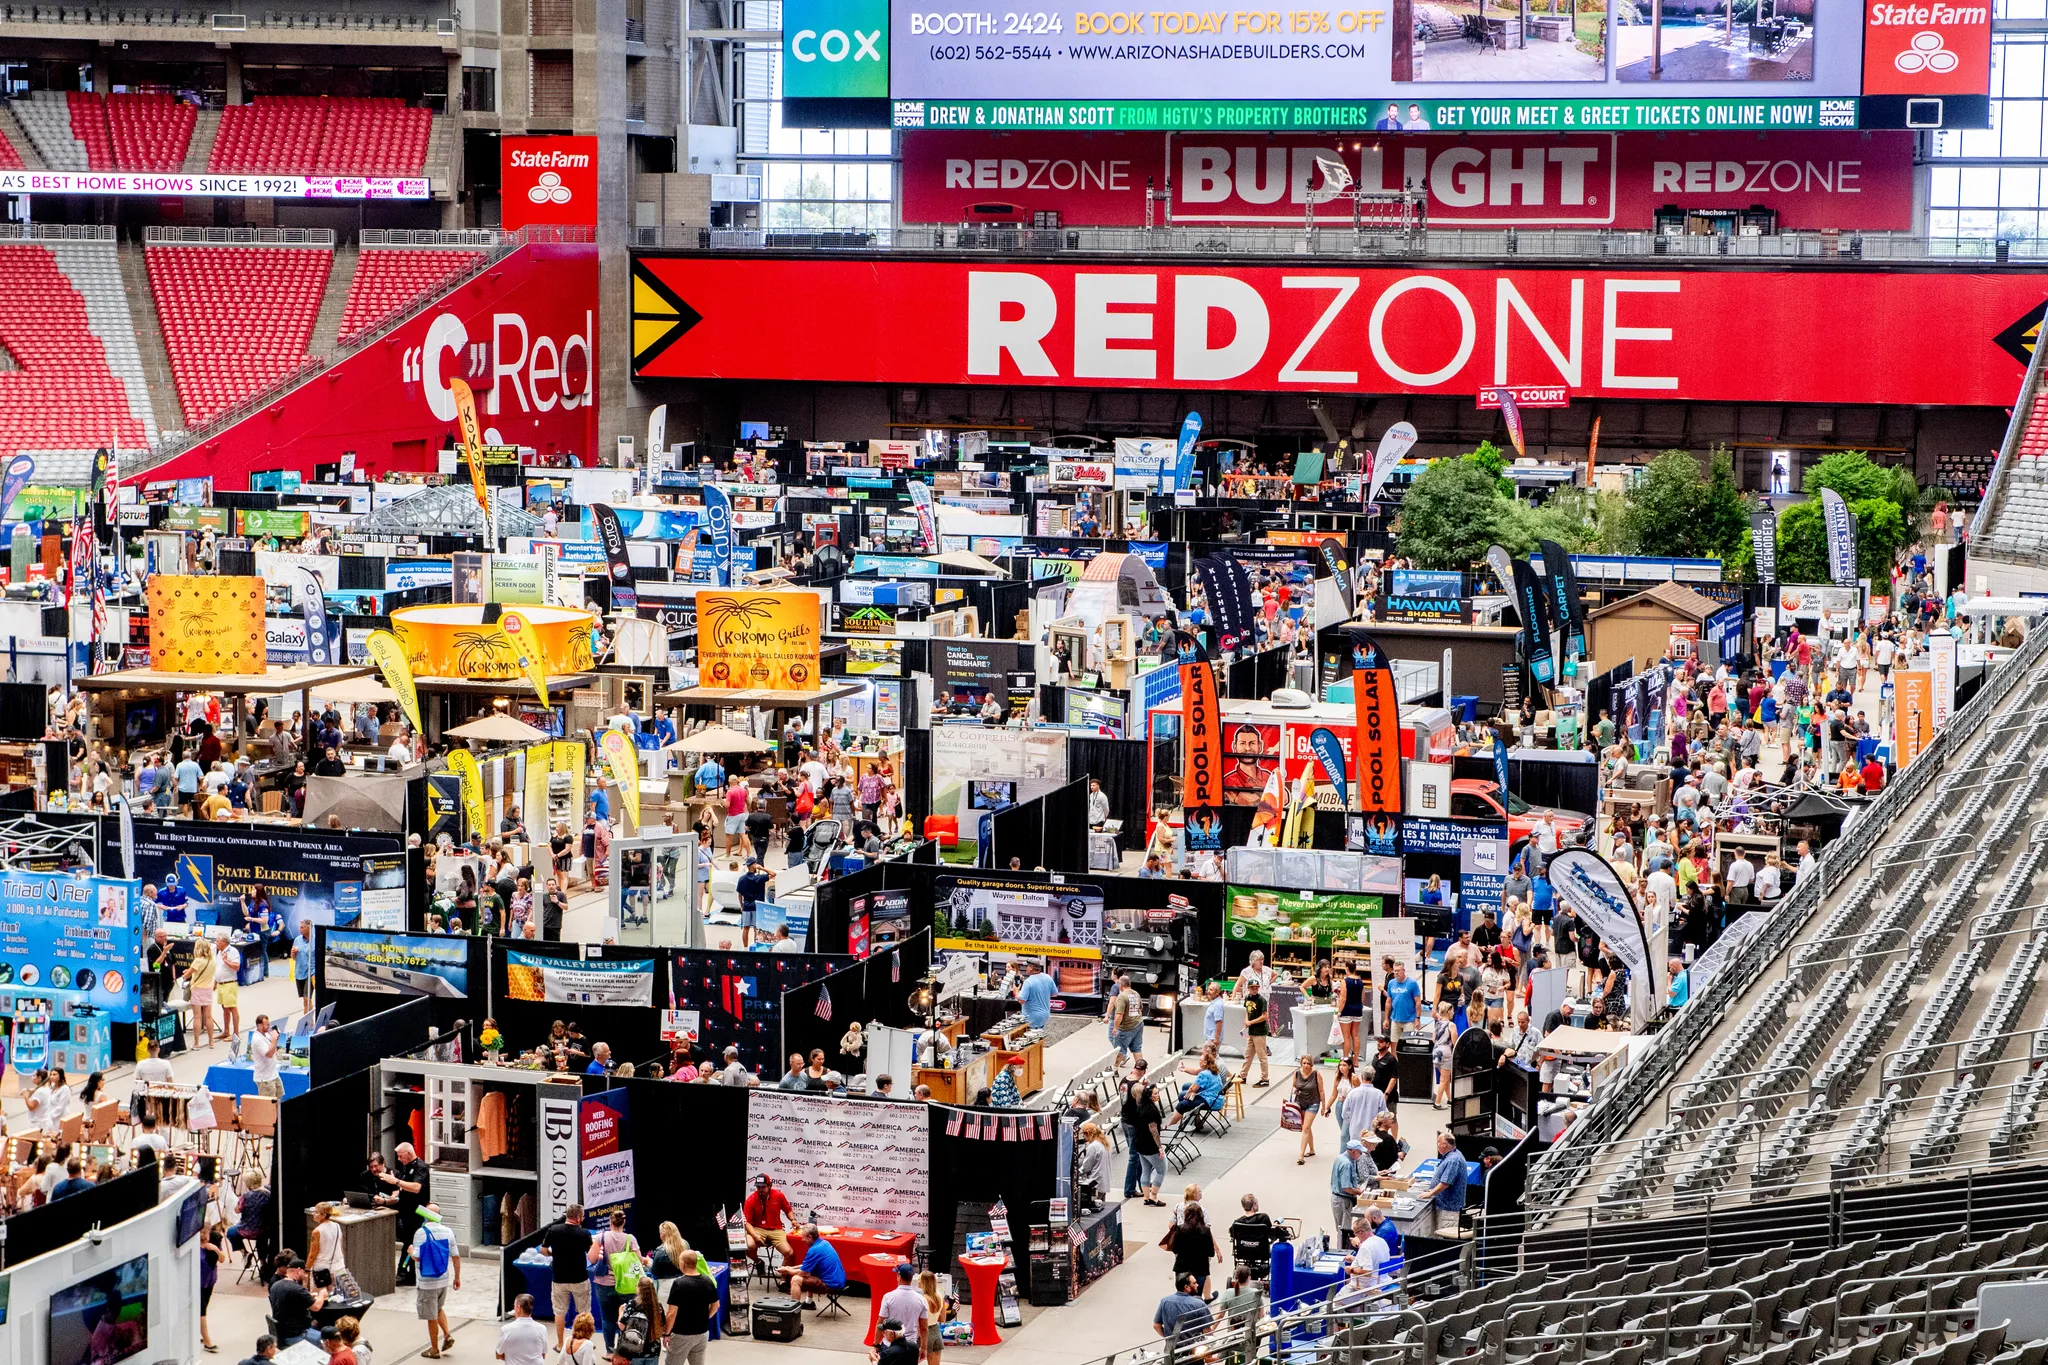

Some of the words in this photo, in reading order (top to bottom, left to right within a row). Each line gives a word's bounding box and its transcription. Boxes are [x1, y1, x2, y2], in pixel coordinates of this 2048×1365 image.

[911, 12, 998, 36] BOOTH:
[1003, 12, 1063, 36] 2424
[1074, 11, 1145, 34] BOOK
[1149, 11, 1228, 34] TODAY
[1233, 11, 1283, 33] FOR
[1288, 10, 1331, 33] 15%
[1336, 9, 1385, 33] OFF
[791, 30, 882, 62] COX
[929, 45, 971, 65] (602)
[975, 45, 1052, 64] 562-5544
[1068, 44, 1366, 61] WWW.ARIZONASHADEBUILDERS.COM
[929, 107, 971, 128] DREW
[975, 107, 987, 127] &
[990, 107, 1064, 127] JONATHAN
[1068, 106, 1115, 127] SCOTT
[1119, 107, 1158, 127] FROM
[1162, 106, 1213, 126] HGTV'S
[1217, 106, 1290, 126] PROPERTY
[1293, 106, 1368, 126] BROTHERS
[1437, 105, 1467, 126] GET
[1471, 105, 1511, 126] YOUR
[1516, 105, 1559, 126] MEET
[1563, 106, 1575, 126] &
[1580, 105, 1631, 126] GREET
[1635, 104, 1701, 125] TICKETS
[1705, 104, 1765, 124] ONLINE
[1769, 104, 1813, 124] NOW!
[945, 158, 1132, 191] REDZONE
[1182, 147, 1350, 205] BUD
[1360, 147, 1599, 208] LIGHT
[1653, 159, 1863, 193] REDZONE
[32, 175, 71, 189] BEST
[76, 177, 127, 191] HOME
[132, 178, 193, 191] SHOWS
[198, 179, 248, 193] SINCE
[254, 181, 298, 194] 1992!
[1698, 209, 1728, 217] Nachos
[966, 270, 1682, 392] REDZONE
[490, 309, 594, 416] Red
[1520, 389, 1566, 402] COURT
[1390, 428, 1412, 439] energy
[1073, 465, 1107, 483] Bulldog
[1835, 501, 1846, 530] MINI
[341, 533, 370, 543] BROUGHT
[370, 534, 380, 543] TO
[379, 534, 392, 544] YOU
[392, 534, 402, 544] BY
[603, 516, 619, 548] CUTCO
[708, 505, 731, 559] CUTCO
[1254, 551, 1270, 559] DREAM
[1838, 535, 1851, 578] SPLITS
[546, 545, 556, 605] RETRACTABLE
[1323, 547, 1349, 592] HAVANA
[494, 581, 518, 590] SCREEN
[518, 582, 537, 590] DOOR
[1207, 567, 1230, 631] KITCHENS
[1386, 595, 1462, 612] HAVANA
[1554, 574, 1571, 620] CARPET
[1525, 585, 1542, 644] FLOORING
[265, 630, 306, 648] Galaxy
[777, 623, 812, 643] Grills
[850, 639, 873, 647] ESPY
[946, 645, 960, 653] Need
[946, 651, 975, 661] CANCEL
[975, 654, 989, 662] your
[946, 658, 991, 669] TIMESHARE?
[1190, 664, 1208, 737] SOLAR
[1364, 670, 1382, 742] SOLAR
[936, 730, 956, 740] AZ
[1296, 736, 1353, 755] GAGE
[1193, 741, 1212, 801] POOL
[1313, 745, 1327, 759] PET
[1322, 757, 1344, 787] DOORS
[1369, 746, 1385, 805] POOL
[1190, 832, 1219, 842] FENIX
[1451, 825, 1472, 834] Doors
[1479, 826, 1500, 835] Glass
[154, 832, 169, 841] THE
[169, 833, 187, 842] BEST
[187, 834, 226, 845] ELECTRICAL
[226, 836, 268, 847] CONTRACTOR
[268, 838, 276, 846] IN
[277, 839, 292, 847] THE
[292, 840, 323, 851] PHOENIX
[323, 842, 343, 852] AREA
[1369, 838, 1394, 848] FENIX
[1476, 852, 1496, 861] HALE
[216, 863, 251, 879] STATE
[253, 865, 322, 884] ELECTRICAL
[1472, 874, 1490, 883] SALES
[3, 880, 42, 899] Triad
[62, 883, 92, 903] Aer
[216, 878, 299, 898] CONTRCTORS
[956, 878, 981, 889] Quality
[981, 881, 1004, 891] garage
[1004, 881, 1026, 890] doors.
[1026, 882, 1055, 893] Superior
[1055, 885, 1081, 894] service.
[992, 890, 1016, 901] Wayne
[1022, 893, 1046, 902] Dalton
[1281, 898, 1305, 908] Never
[1305, 901, 1324, 909] have
[1325, 901, 1339, 911] dry
[1339, 901, 1355, 909] skin
[1356, 902, 1379, 911] again
[43, 905, 53, 915] Air
[53, 906, 90, 919] Purification
[1147, 910, 1174, 918] GENIE
[65, 925, 92, 938] Problems
[93, 928, 111, 941] With?
[1315, 926, 1344, 937] Infinite
[331, 940, 380, 952] STAFFORD
[380, 943, 410, 954] HOME
[410, 946, 433, 956] AND
[964, 941, 974, 949] Be
[986, 942, 999, 950] talk
[1007, 945, 1023, 953] your
[1024, 944, 1072, 956] neighborhood!
[364, 953, 427, 967] 480.415.7672
[520, 954, 543, 966] SUN
[545, 957, 586, 970] VALLEY
[588, 959, 619, 970] BEES
[621, 960, 641, 971] LLC
[758, 1092, 788, 1101] AMERICA
[848, 1101, 879, 1109] AMERICA
[592, 1110, 605, 1120] NEED
[584, 1117, 614, 1135] ROOFING
[588, 1129, 611, 1143] EXPERTS?
[597, 1160, 631, 1174] AMERICA
